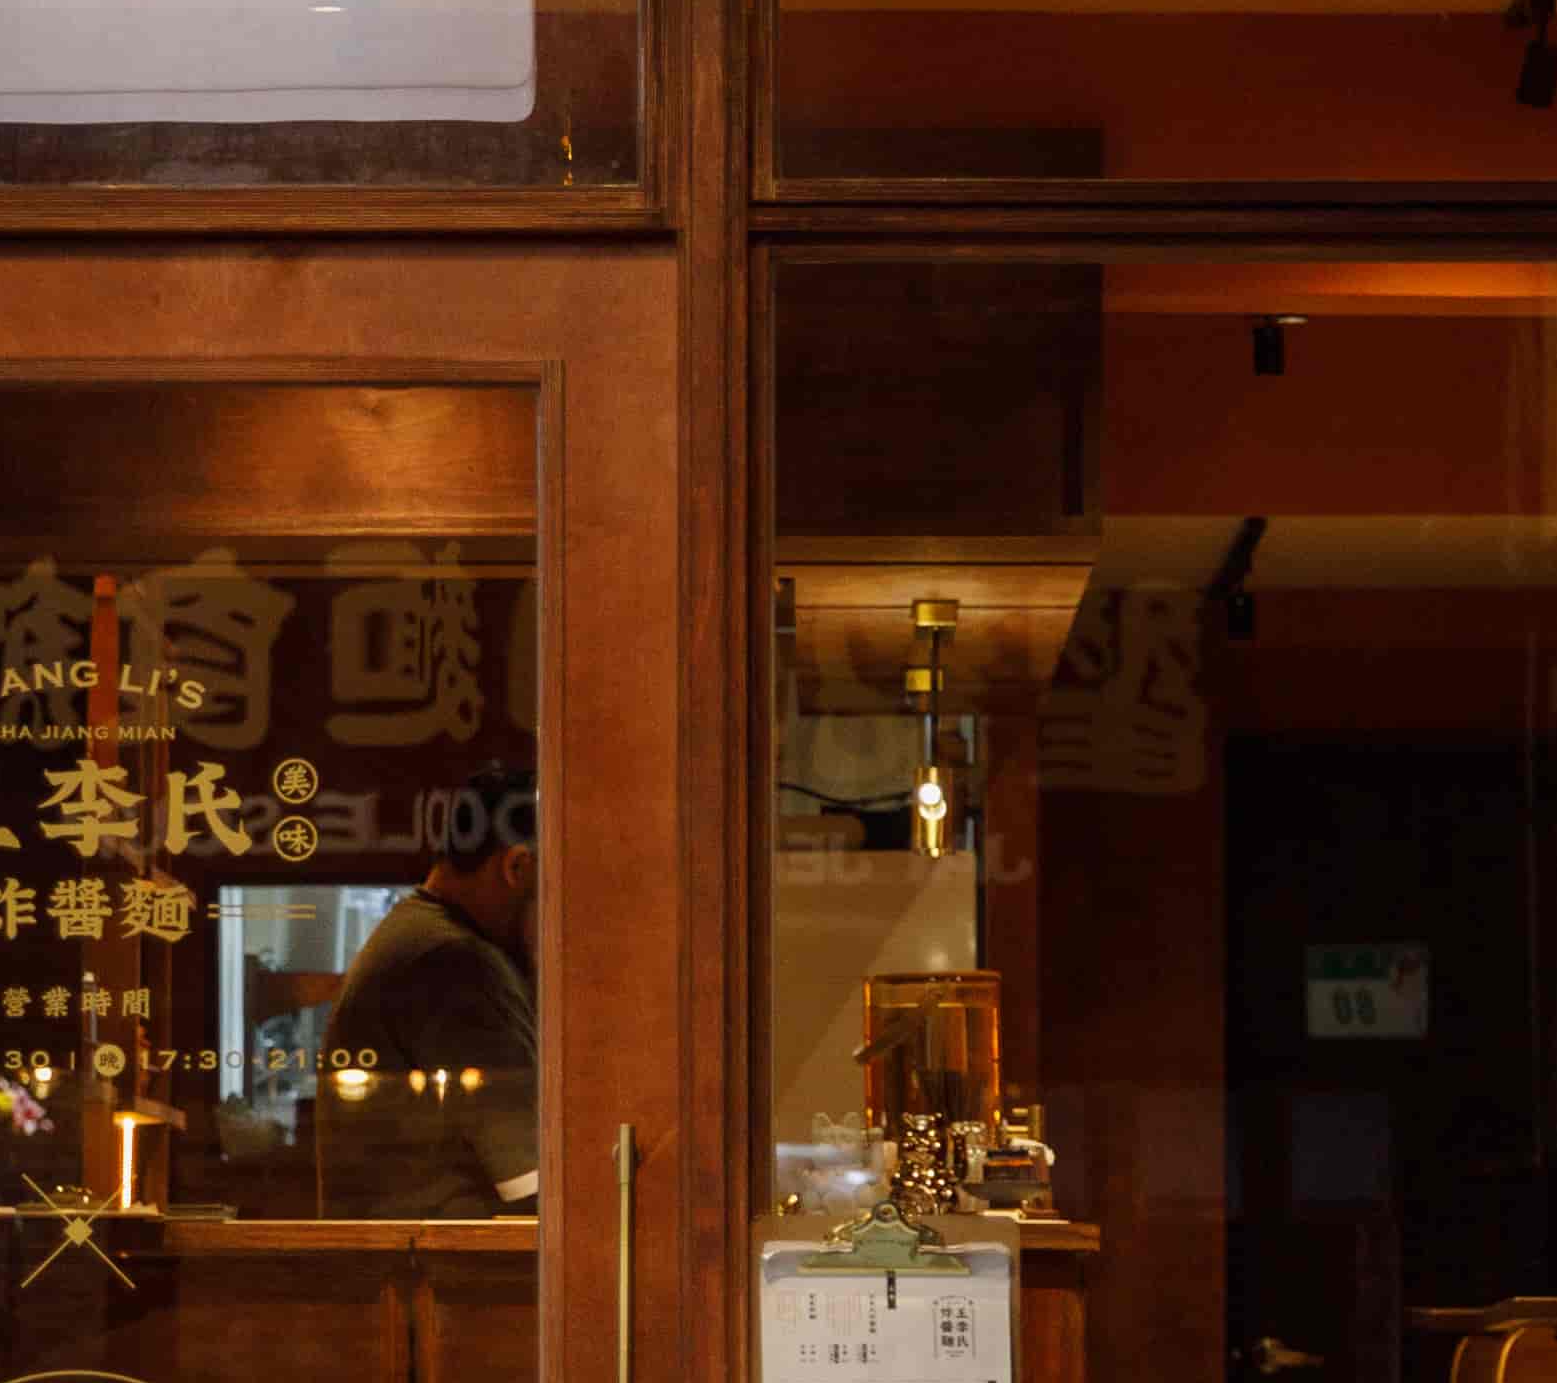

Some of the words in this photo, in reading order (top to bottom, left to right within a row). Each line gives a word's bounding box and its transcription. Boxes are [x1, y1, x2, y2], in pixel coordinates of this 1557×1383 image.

[118, 668, 206, 710] LI'S
[40, 723, 110, 741] JIANG
[117, 723, 177, 741] MIAN
[274, 761, 315, 857] 美味
[0, 986, 153, 1020] 營業時間
[140, 1047, 380, 1070] 17:30-21:00
